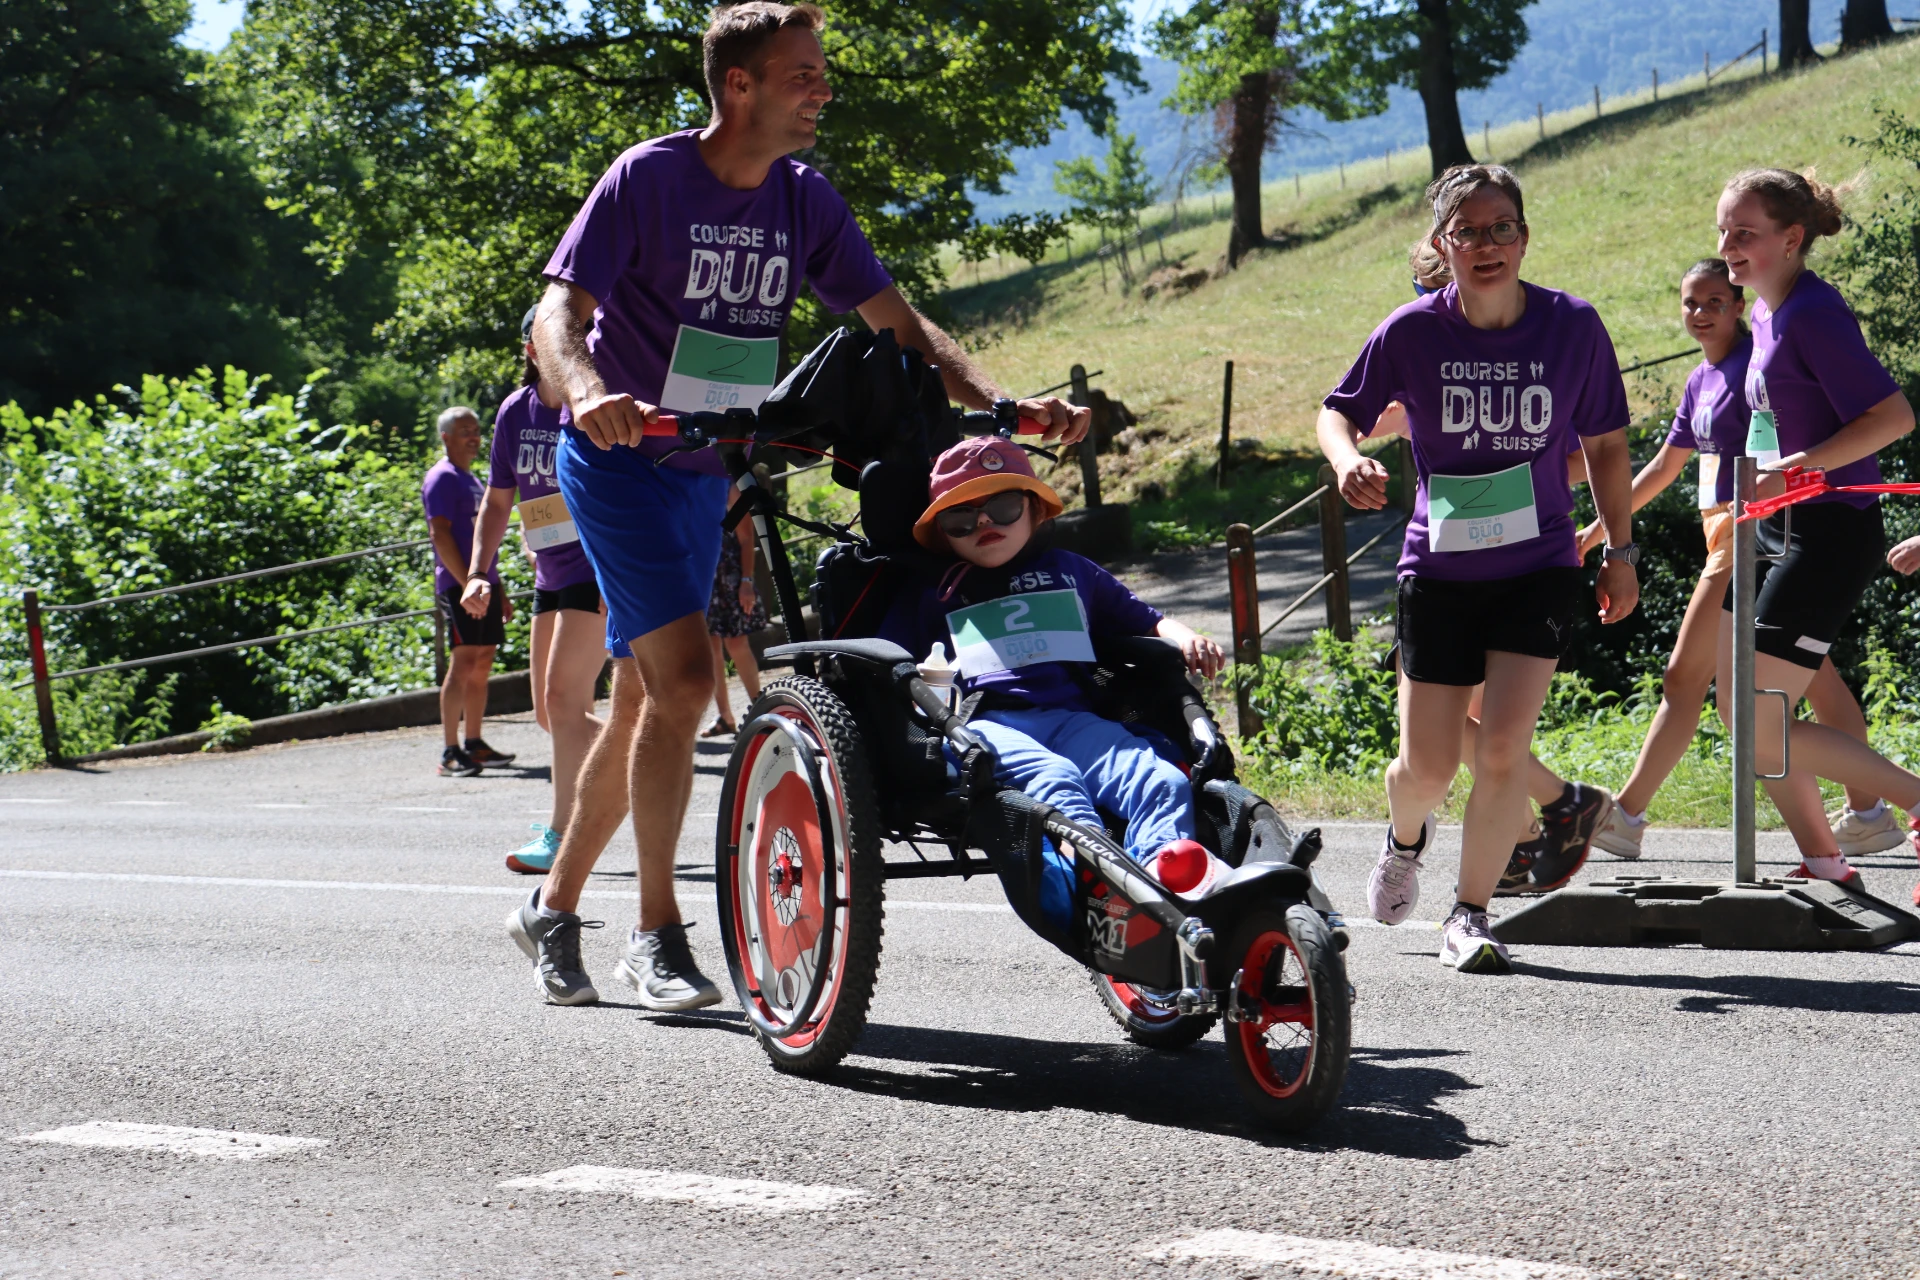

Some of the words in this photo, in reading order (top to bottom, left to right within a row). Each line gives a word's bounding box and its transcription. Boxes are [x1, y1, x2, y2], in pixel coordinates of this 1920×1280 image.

[690, 224, 765, 248] COURSE
[684, 248, 789, 307] DUO
[707, 343, 750, 379] 2
[1440, 361, 1519, 380] COURSE
[704, 389, 739, 406] DUO
[1441, 385, 1553, 434] DUO
[1492, 434, 1548, 451] SUISSE
[517, 443, 557, 476] DU
[1460, 479, 1498, 510] 2
[530, 503, 552, 522] 146
[1468, 522, 1504, 540] DUO
[1010, 571, 1053, 591] RSE
[1000, 600, 1034, 632] 2
[1005, 639, 1048, 656] DUO
[1087, 910, 1128, 955] M1
